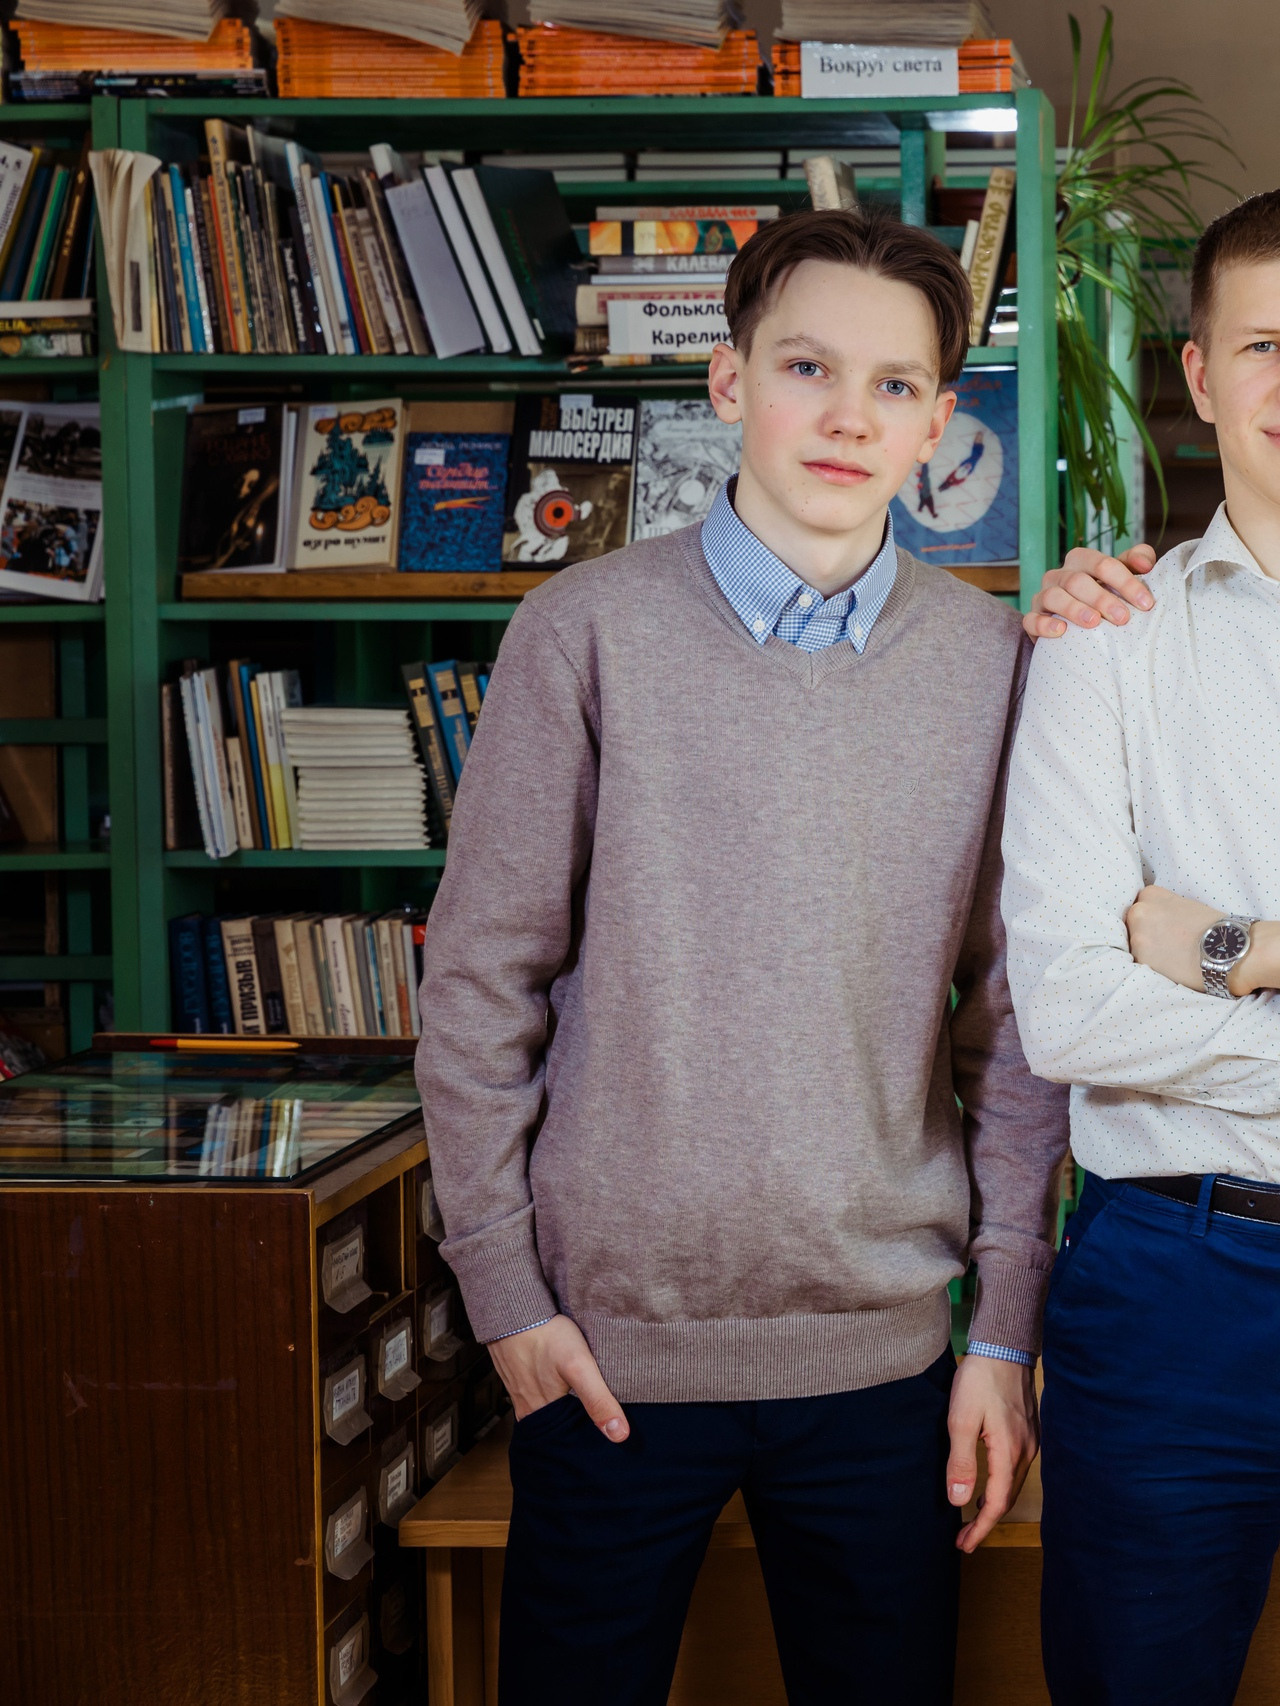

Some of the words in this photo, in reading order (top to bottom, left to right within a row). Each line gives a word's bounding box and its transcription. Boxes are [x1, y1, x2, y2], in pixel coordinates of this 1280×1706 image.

[819, 56, 886, 78] Вокруг
[893, 57, 943, 74] света
[559, 407, 635, 433] ВЫСТРЕЛ
[528, 430, 632, 463] МИЛОСЕРДИЯ
[235, 958, 261, 1018] ПРИЗЫВ
